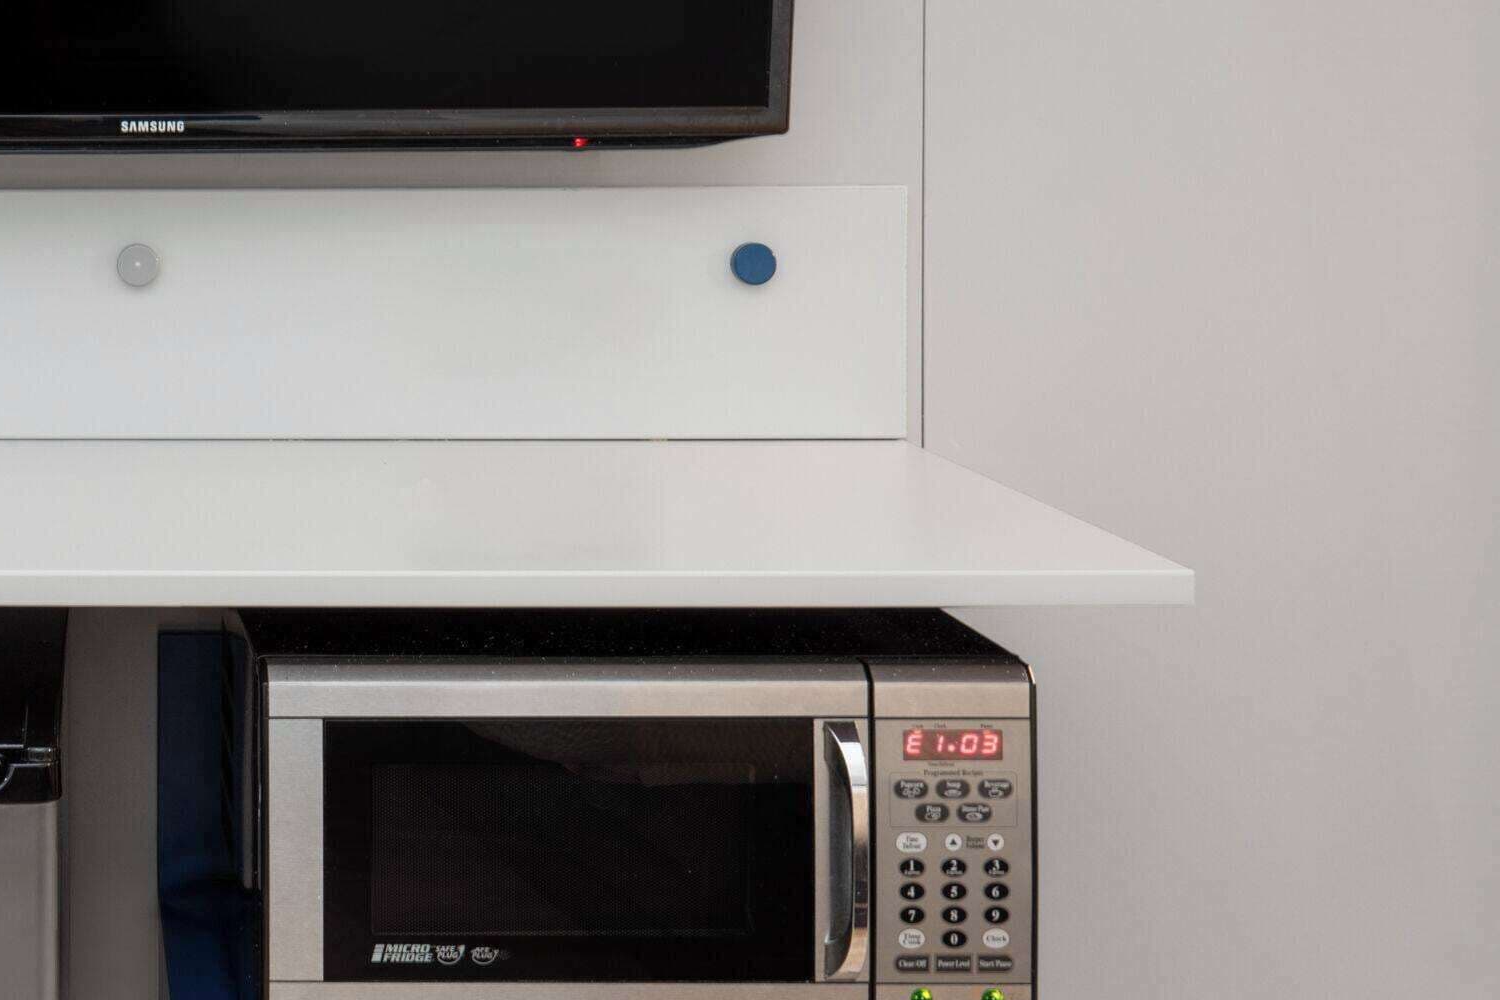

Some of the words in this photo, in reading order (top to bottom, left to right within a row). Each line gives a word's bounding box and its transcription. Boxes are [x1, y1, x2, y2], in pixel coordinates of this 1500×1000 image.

[121, 121, 185, 132] SAMSUNG
[910, 859, 915, 871] 1
[950, 859, 958, 871] 2
[992, 859, 1000, 871] 3
[907, 886, 916, 898] 4
[950, 886, 958, 898] 5
[991, 886, 1000, 898] 6
[908, 909, 916, 921] 7
[950, 909, 958, 921] 8
[992, 909, 1000, 921] 9
[950, 933, 958, 944] 0
[385, 944, 431, 953] MICRO
[382, 953, 433, 963] FRIDGE
[438, 951, 459, 959] PLUG
